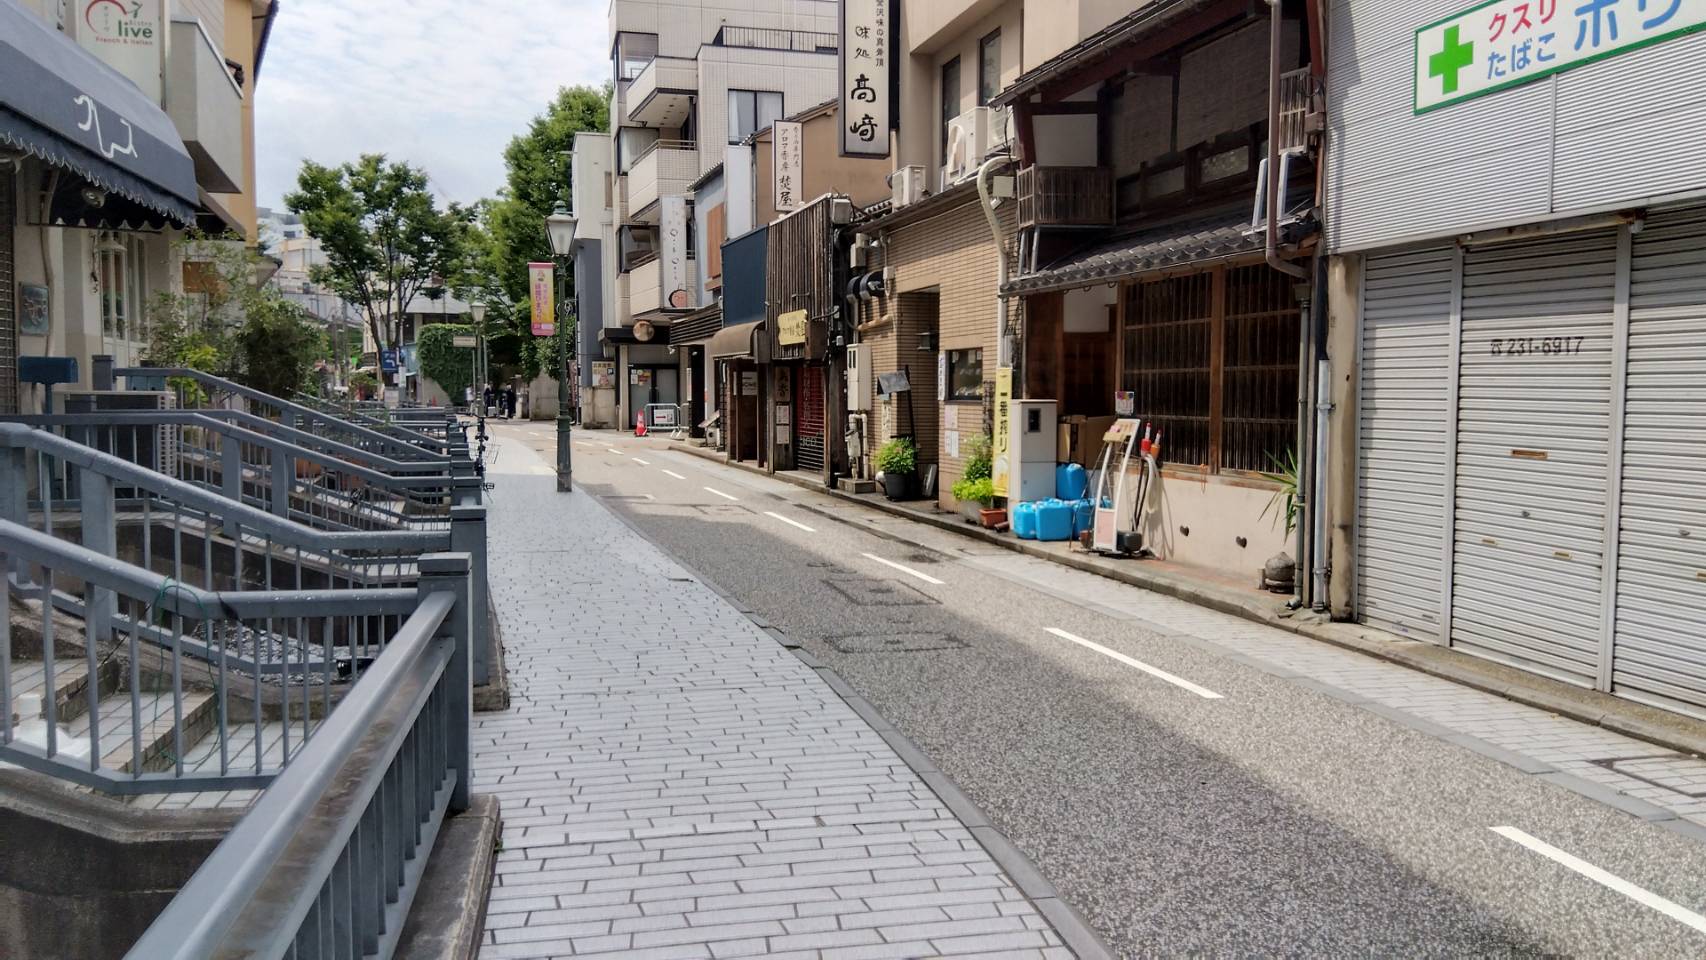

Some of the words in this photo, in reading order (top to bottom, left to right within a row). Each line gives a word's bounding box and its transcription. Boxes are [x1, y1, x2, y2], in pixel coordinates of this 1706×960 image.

[1488, 0, 1557, 43] クスリ
[1487, 32, 1556, 80] たばこ
[1507, 336, 1585, 354] 231-6917
